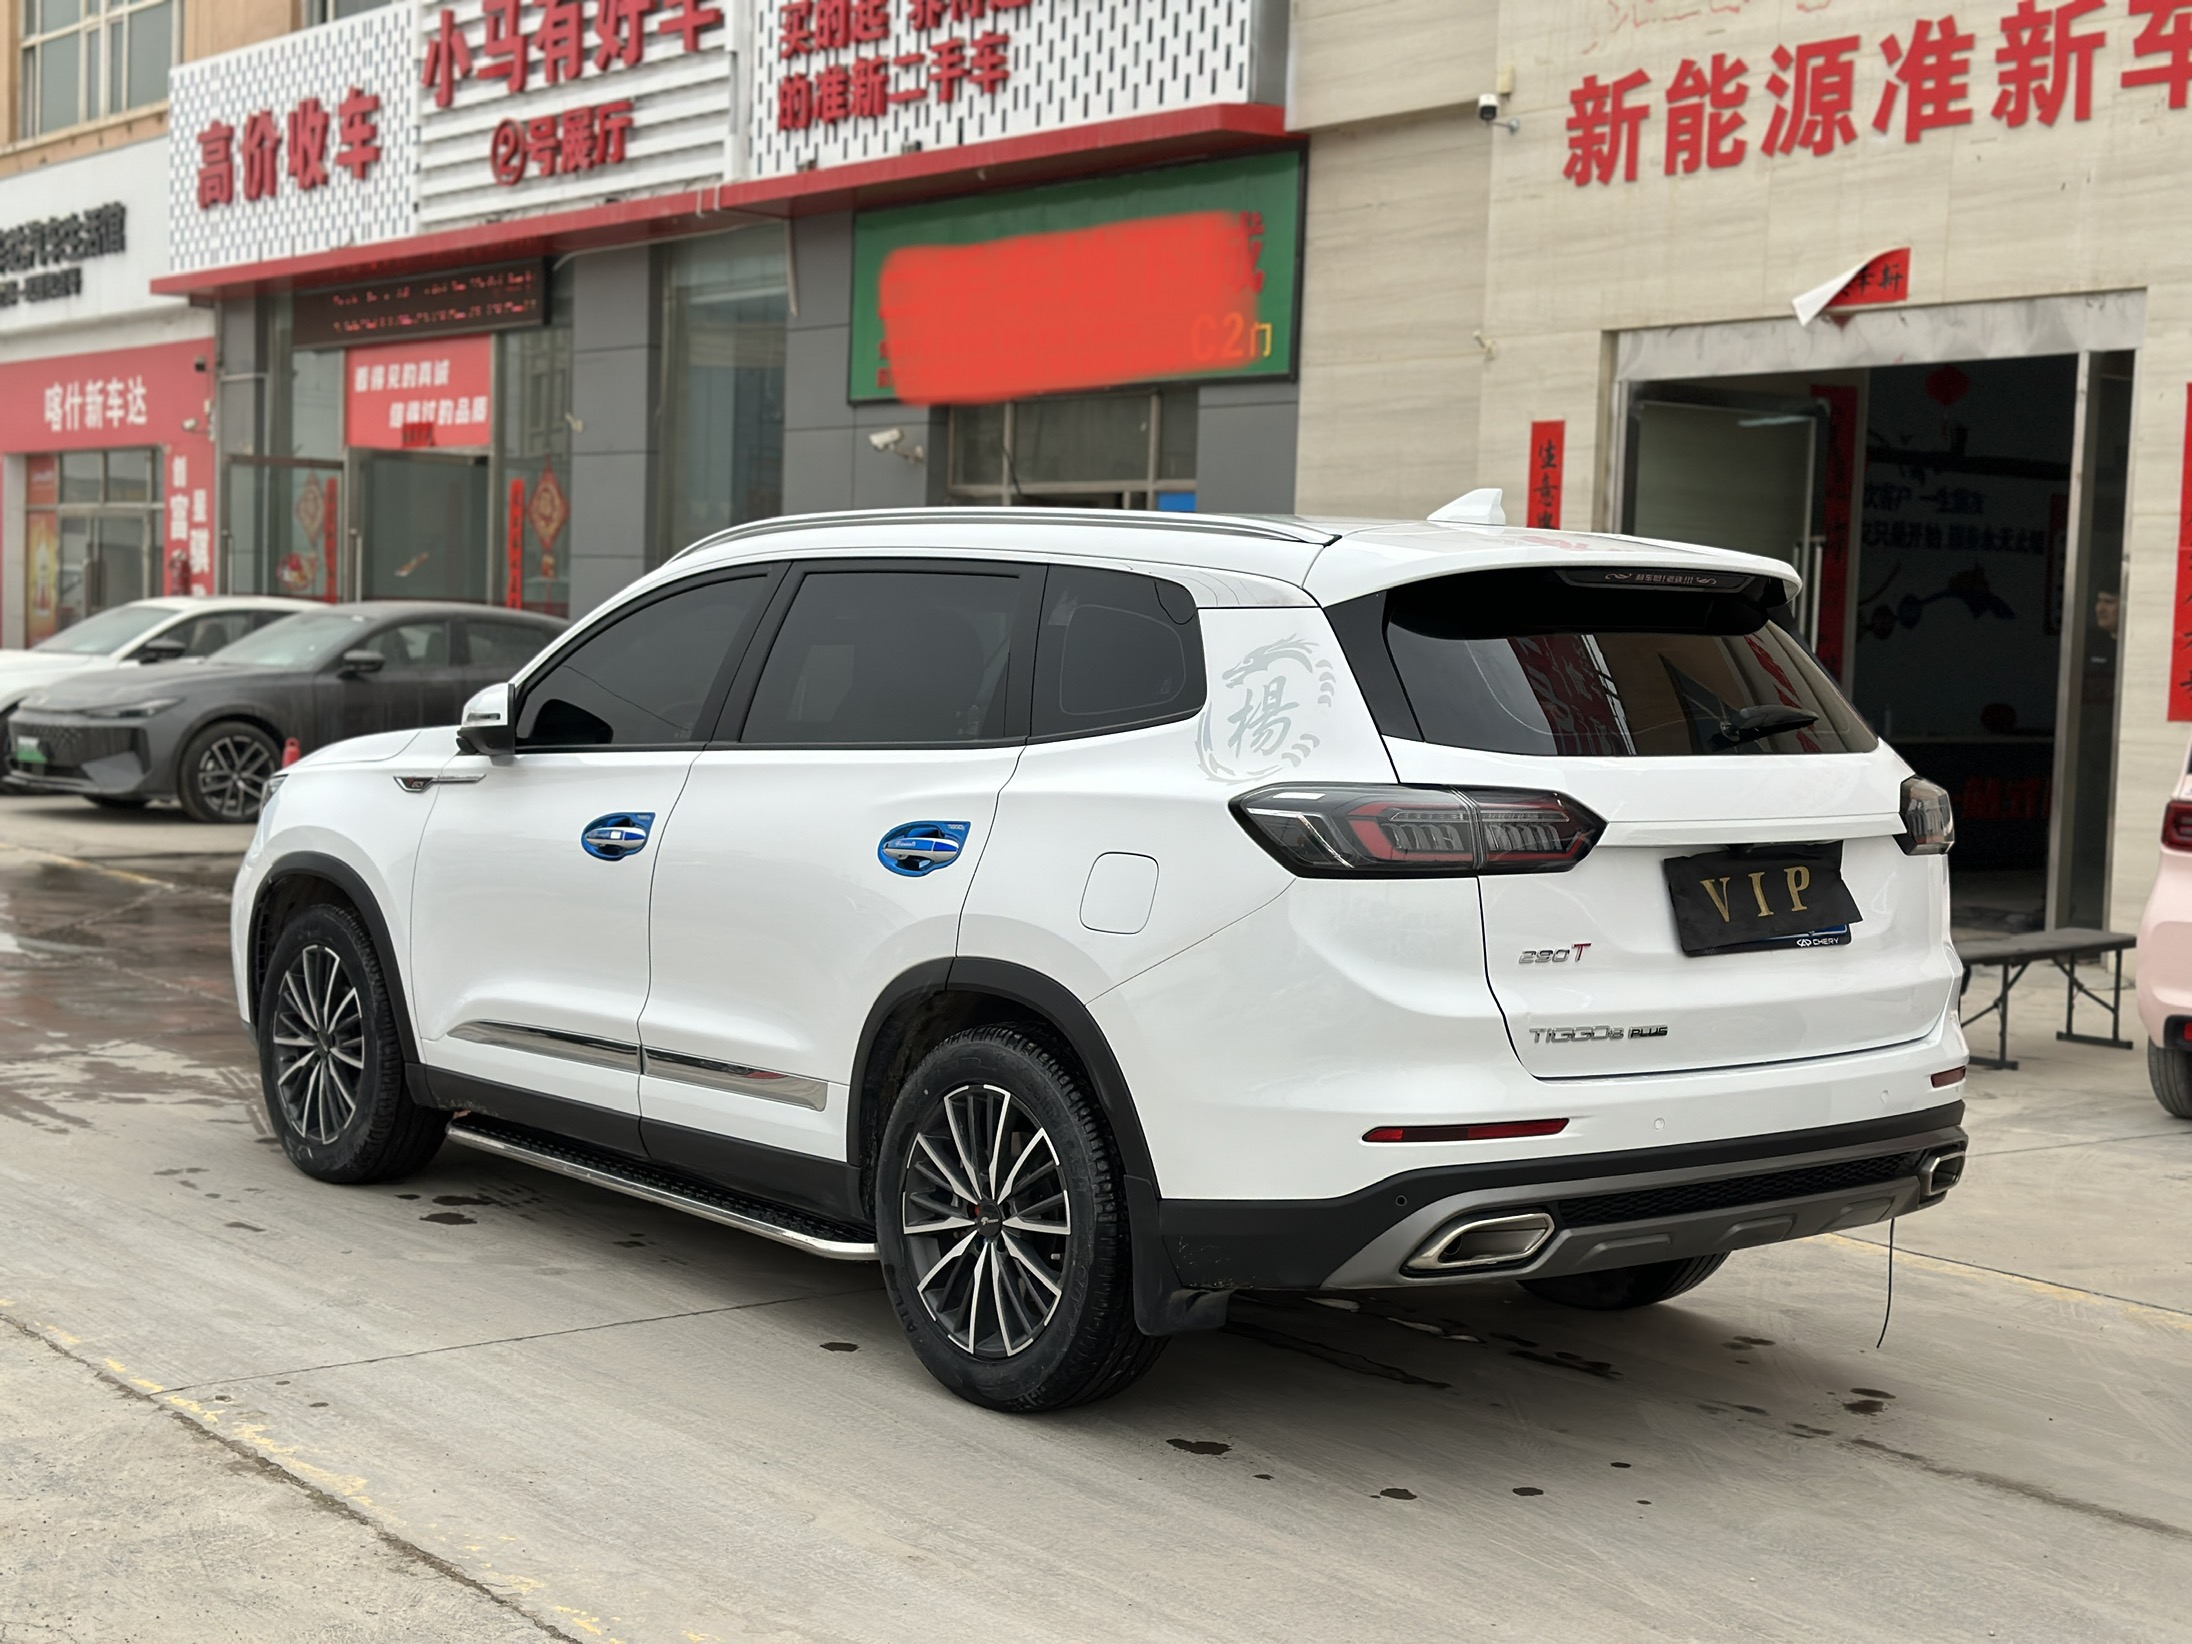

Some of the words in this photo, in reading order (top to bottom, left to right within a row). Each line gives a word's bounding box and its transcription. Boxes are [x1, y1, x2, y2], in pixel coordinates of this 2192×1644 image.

[779, 31, 1010, 131] 的准新二手车
[197, 85, 382, 210] 高价收车
[44, 375, 148, 432] 喀什新车达
[1700, 865, 1811, 924] VIP
[1518, 942, 1592, 964] 290T
[1812, 936, 1840, 946] CHERY
[1628, 1025, 1669, 1039] PLUS
